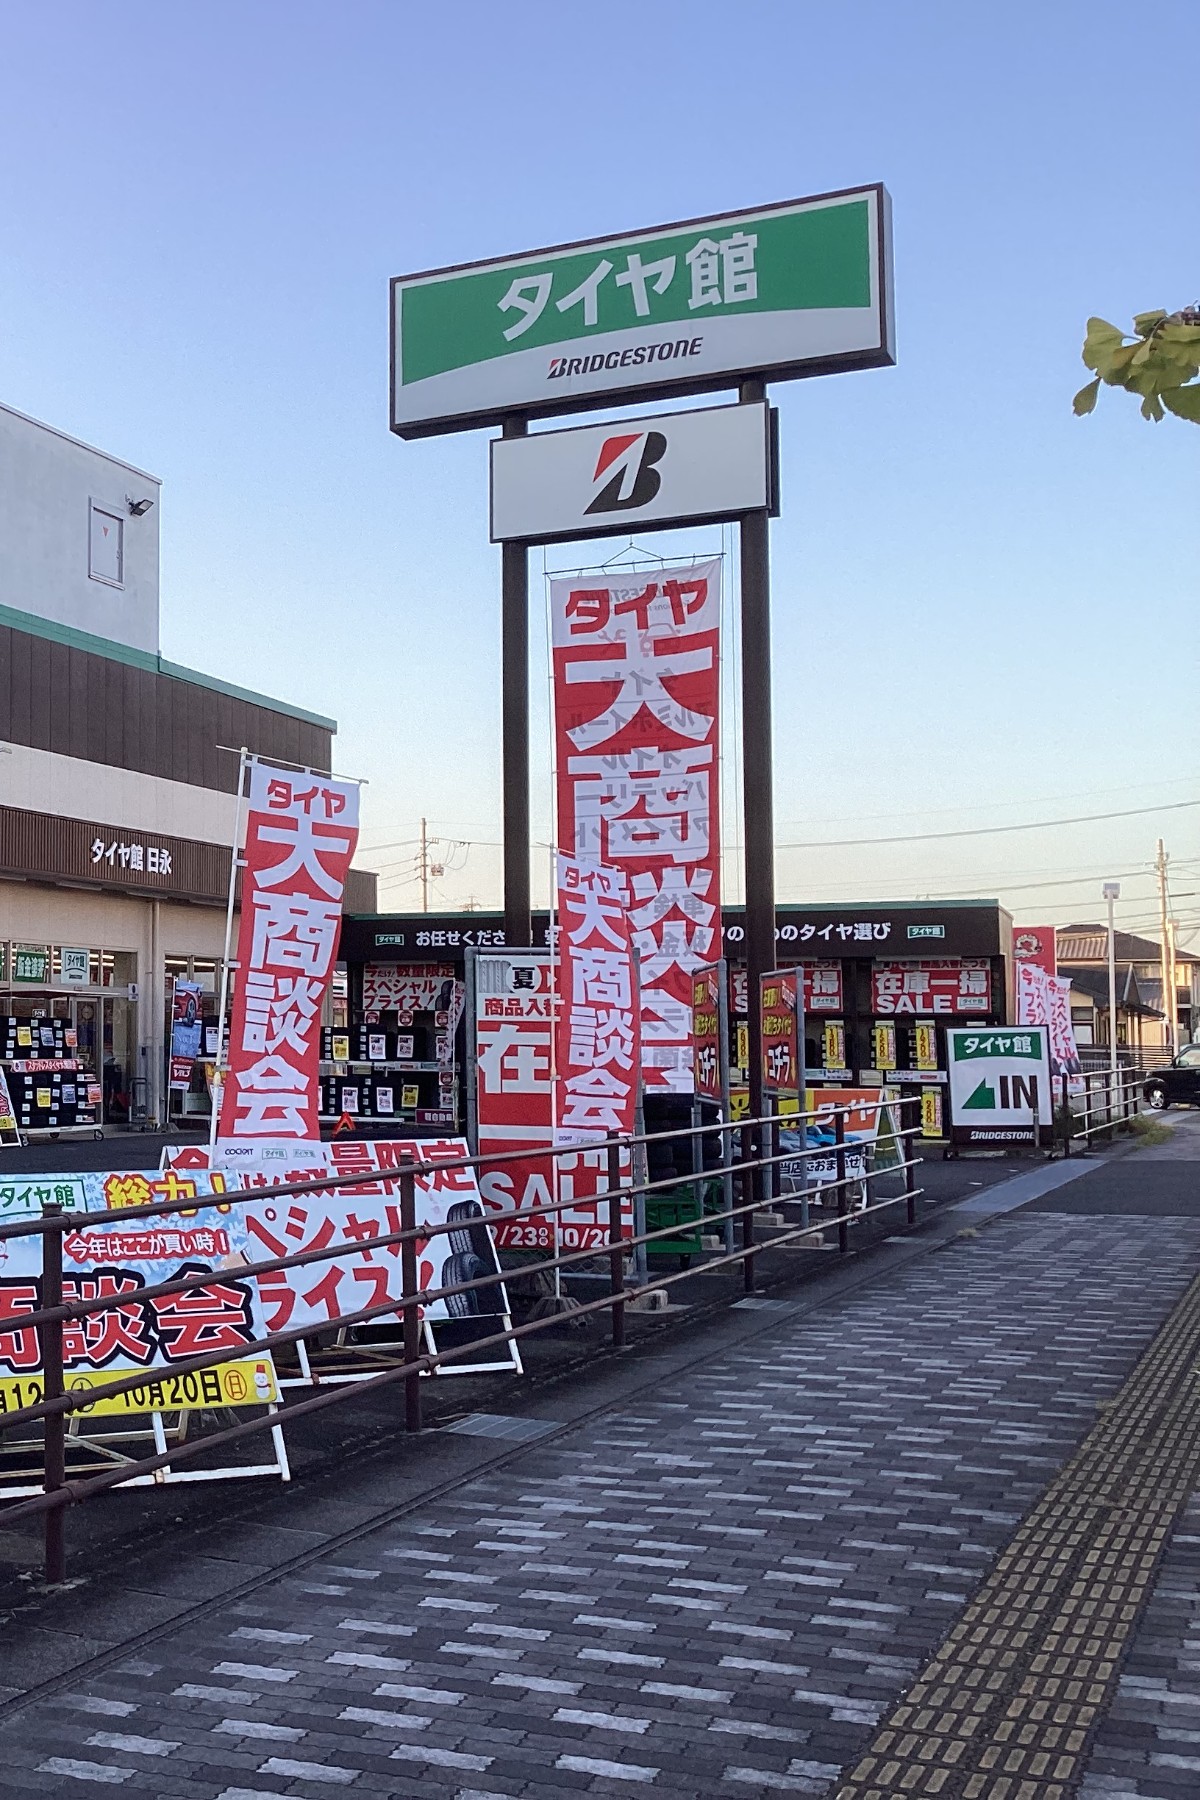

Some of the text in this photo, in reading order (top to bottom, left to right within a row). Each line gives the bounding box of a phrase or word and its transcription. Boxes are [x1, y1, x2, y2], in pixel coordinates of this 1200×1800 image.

[497, 231, 758, 341] タイヤ館
[547, 336, 704, 379] BRIDGESTONE
[566, 578, 708, 635] タイヤ
[267, 779, 346, 818] タイヤ
[90, 838, 144, 871] タイヤ館
[566, 866, 611, 893] タイヤ
[234, 820, 350, 1137] 大商談会
[364, 979, 437, 995] スペシャル
[512, 966, 535, 990] 夏
[875, 970, 988, 995] 在庫一掃
[364, 994, 435, 1011] プライス！
[562, 890, 635, 1131] 大商談会
[876, 994, 953, 1013] SALE
[963, 1036, 1032, 1053] タイヤ館
[999, 1075, 1039, 1109] IN
[970, 1130, 1035, 1140] BRIDGESTONE
[68, 1234, 228, 1259] 今年はここが買い時！
